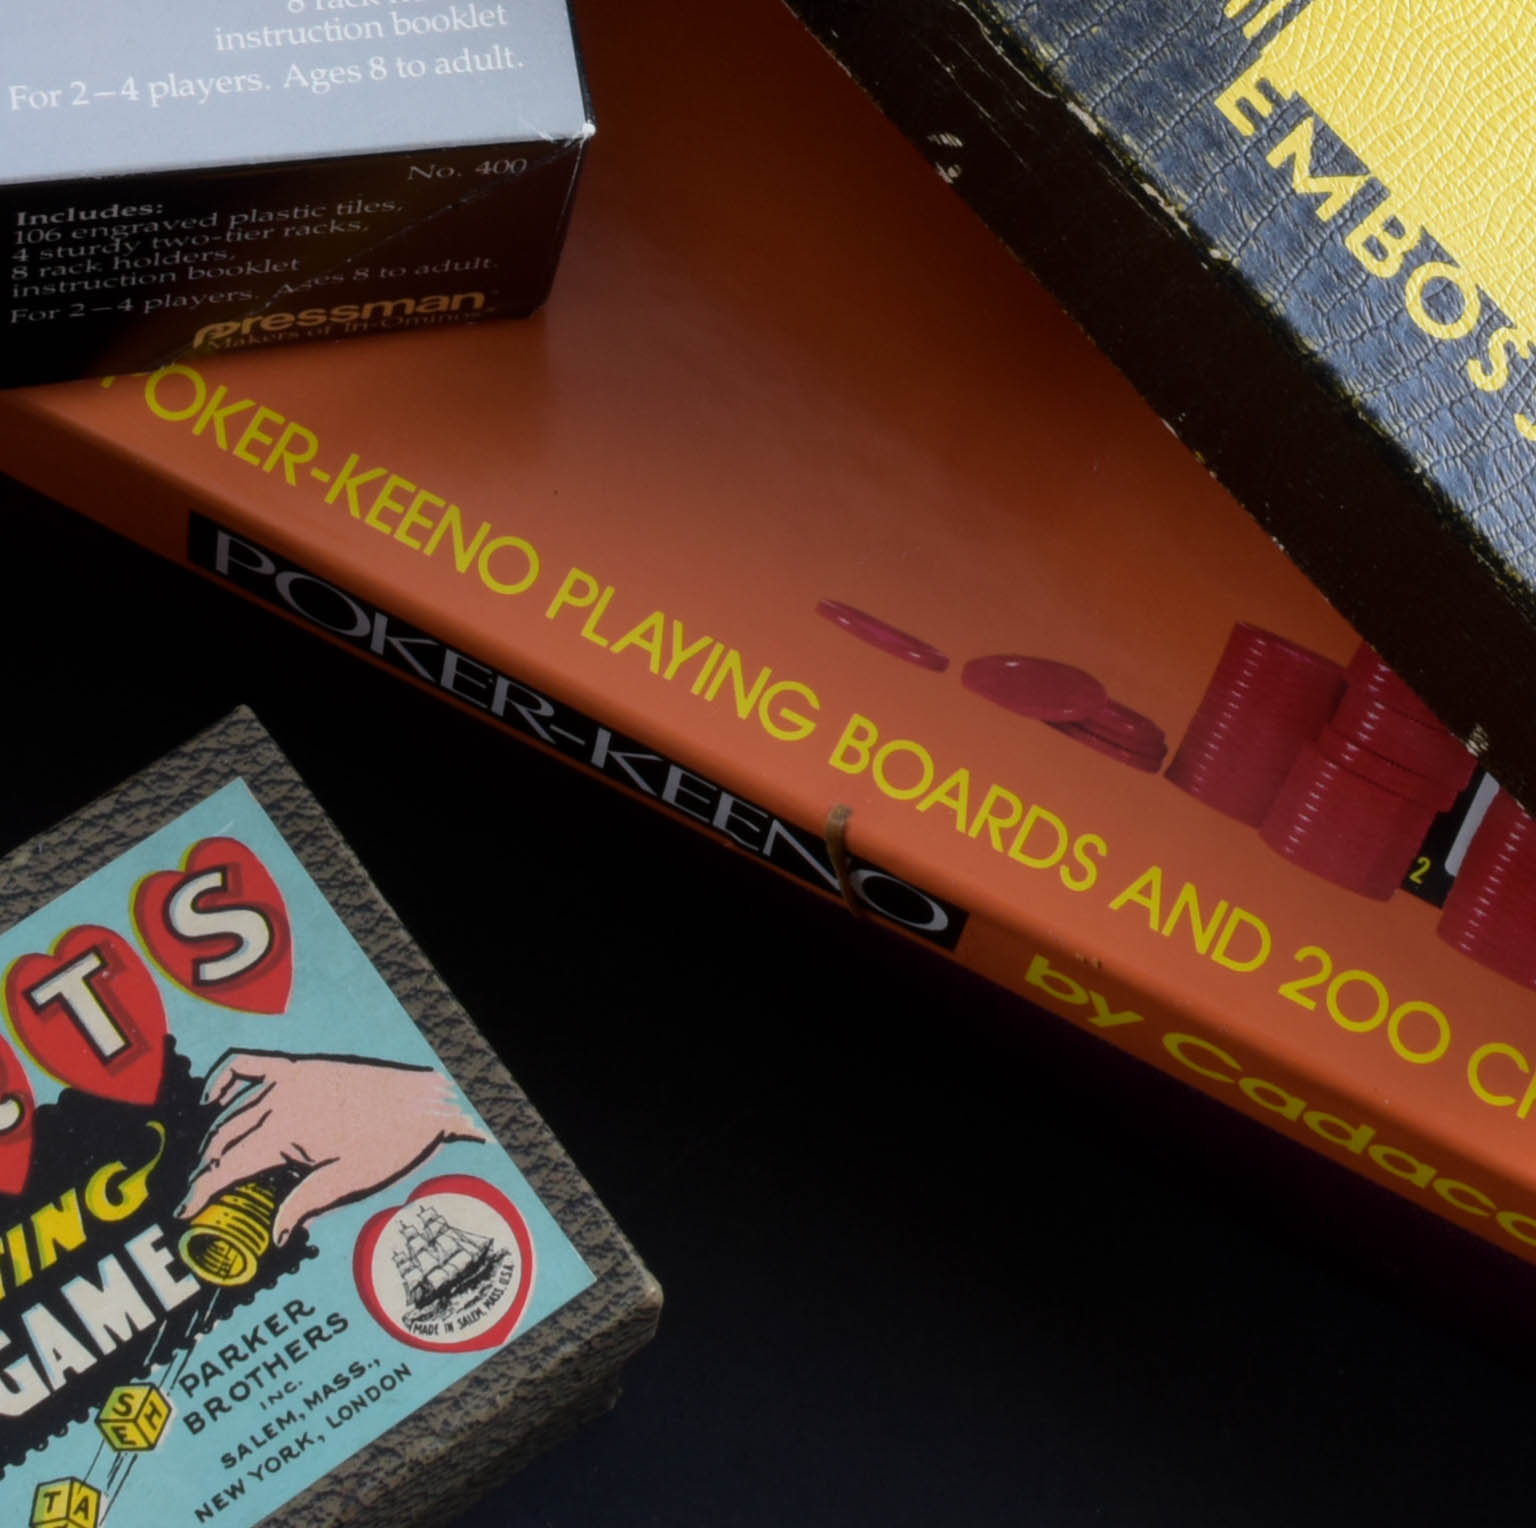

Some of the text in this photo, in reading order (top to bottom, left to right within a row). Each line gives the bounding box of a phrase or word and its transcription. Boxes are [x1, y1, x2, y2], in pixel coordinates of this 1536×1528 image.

[214, 4, 508, 54] instruction booklet
[8, 83, 63, 112] For
[147, 70, 271, 109] players.
[283, 59, 362, 96] Ages
[368, 55, 388, 81] 8
[395, 52, 428, 78] to
[435, 44, 525, 76] adult.
[406, 158, 528, 182] No. 400
[191, 290, 488, 350] pressman
[101, 364, 540, 596] OKER-KEENO
[546, 567, 824, 743] PLAYING
[827, 713, 1109, 893] BOARDS
[1109, 866, 1272, 974] AND
[1277, 944, 1452, 1065] 200
[214, 529, 950, 934] POKER-KEENO
[1024, 953, 1146, 1030] by
[178, 1298, 319, 1398] PARKER
[183, 1310, 351, 1435] BROTHERS
[261, 1380, 304, 1412] INC.
[193, 1362, 415, 1526] NEW YORK, LONDON
[219, 1408, 307, 1471] SALEM,
